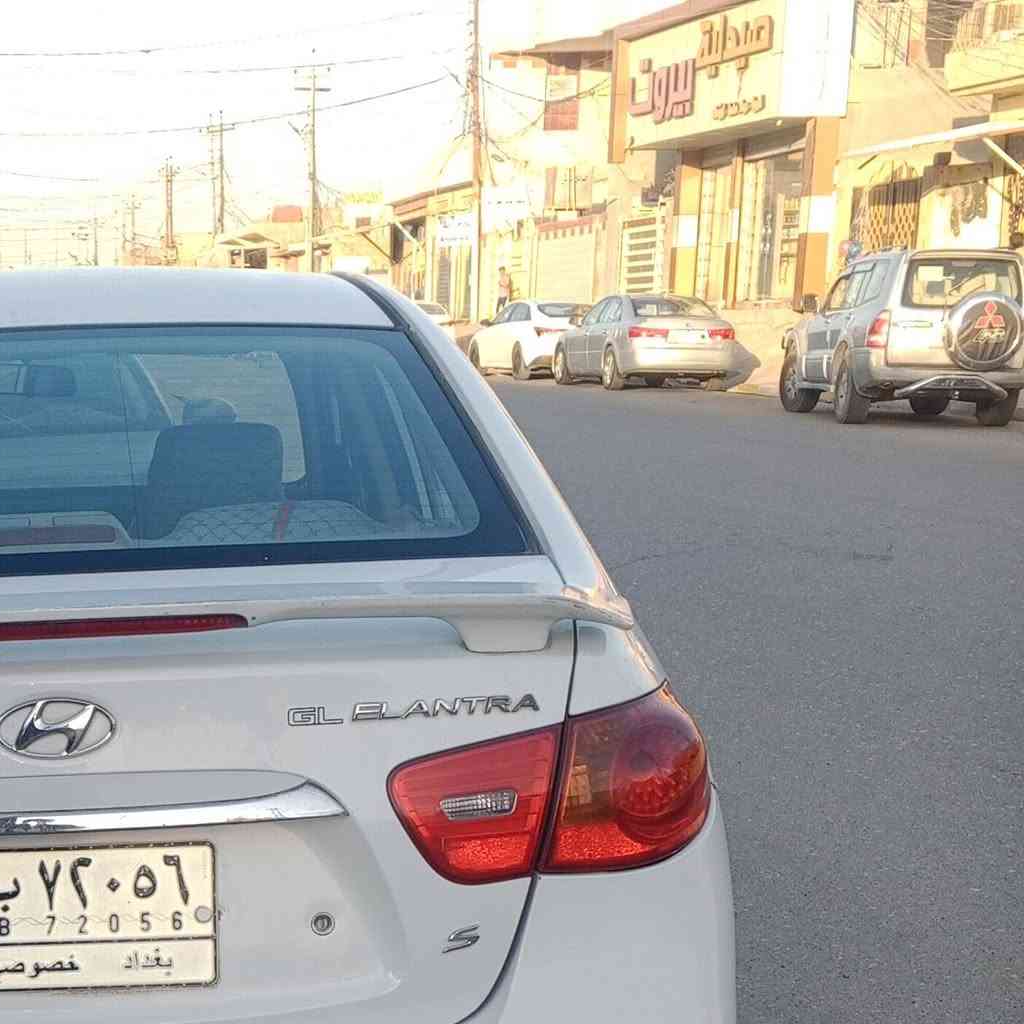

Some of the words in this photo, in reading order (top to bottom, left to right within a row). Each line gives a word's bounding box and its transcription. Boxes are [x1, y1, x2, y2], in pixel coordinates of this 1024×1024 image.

[695, 14, 774, 79] صيدلية
[629, 57, 696, 125] بيروت
[287, 706, 344, 727] GL
[351, 693, 541, 722] ELANTRA
[441, 924, 480, 954] S
[123, 947, 174, 976] بغداد
